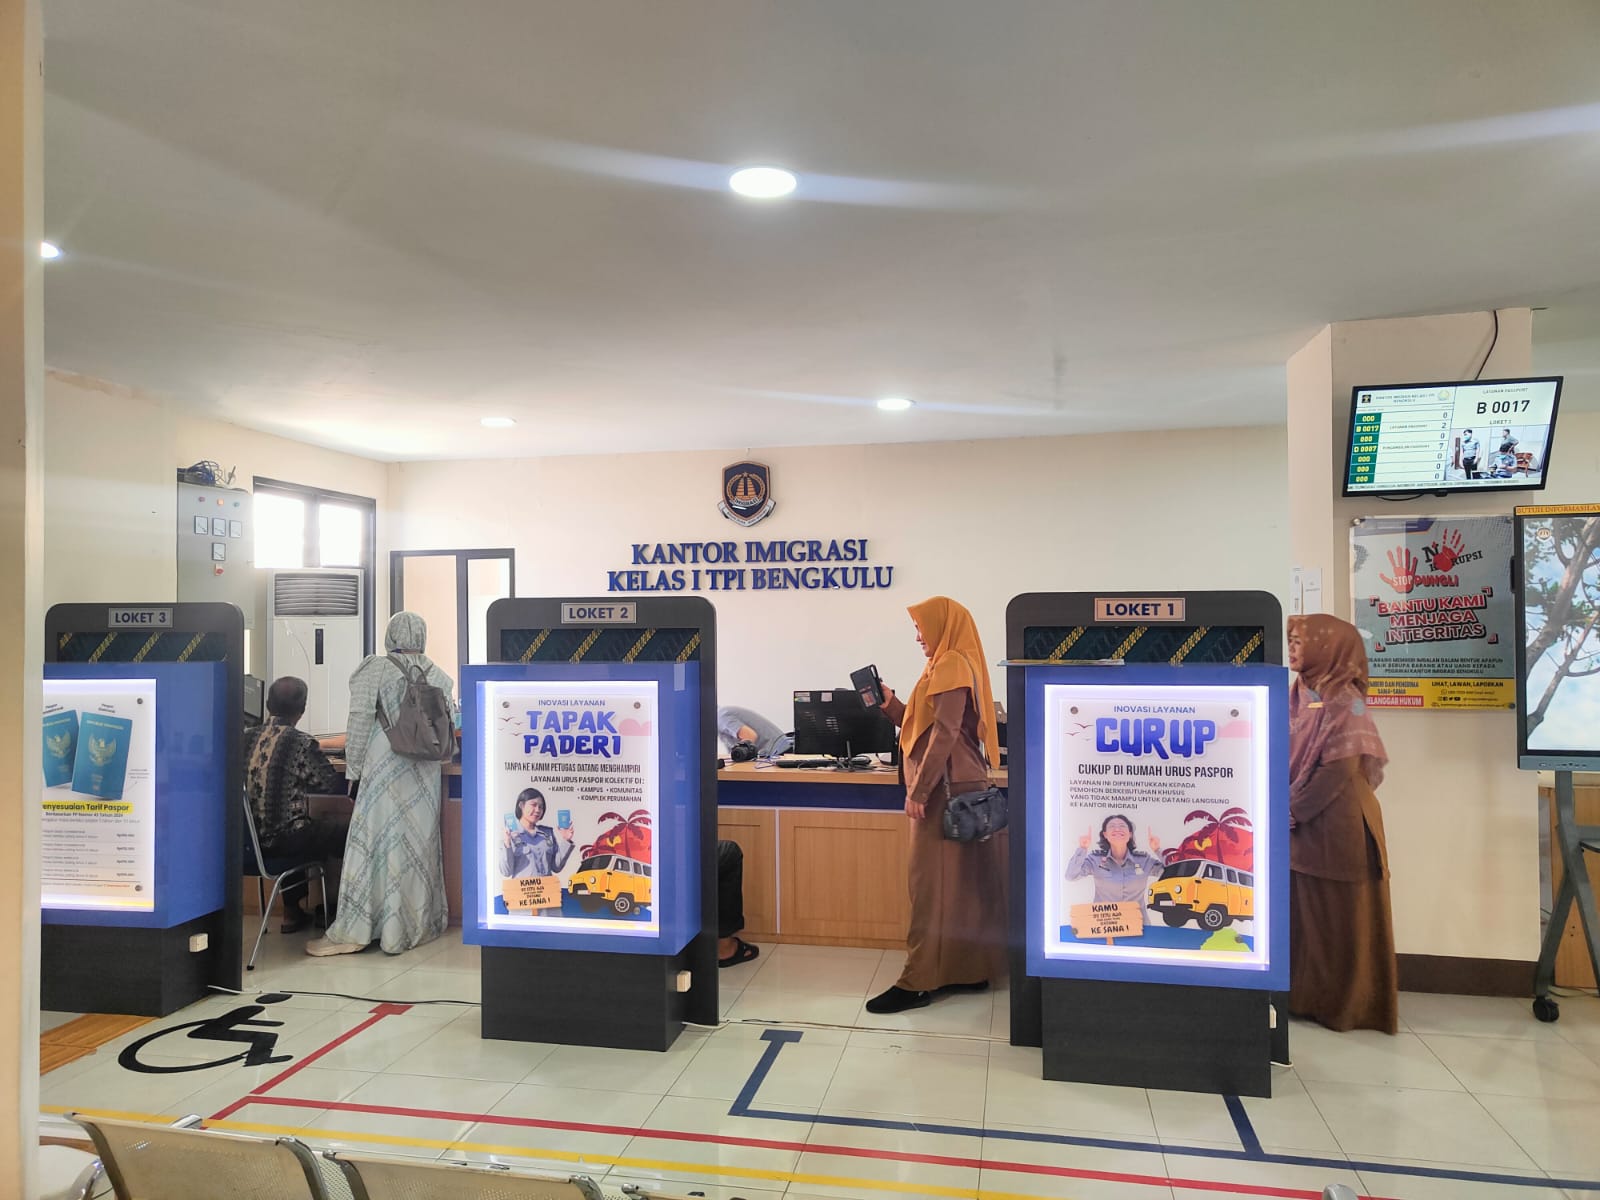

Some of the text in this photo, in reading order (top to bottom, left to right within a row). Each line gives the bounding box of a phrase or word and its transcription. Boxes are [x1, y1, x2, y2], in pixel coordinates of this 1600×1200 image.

[1477, 400, 1530, 414] B 0017
[631, 539, 868, 565] KANTOR IMIGRASI
[1429, 550, 1483, 572] KRUPSI
[607, 566, 894, 591] KELAS I TPI BENGKULU
[1393, 574, 1459, 587] STOP PUNGLI
[1106, 603, 1174, 616] LOKET 1
[1378, 594, 1485, 615] BANTU KAMI
[115, 612, 166, 624] LOKET 3
[569, 607, 628, 619] LOKET 2
[1390, 610, 1476, 627] MENJAGA
[1385, 624, 1485, 643] INTEGRITAS
[1113, 705, 1196, 714] INOVASI LAYANAN
[526, 710, 618, 733] TAPAK
[1096, 717, 1216, 760] CURUP
[523, 735, 621, 758] PADERI
[505, 762, 641, 773] TANPA KE KANIM PETUGAS DATANG MENGHAMPIRI
[1078, 764, 1233, 778] CUKUP DI RUMAH URUS PASPOR
[42, 803, 85, 811] enyesuaian
[104, 804, 129, 812] Paspor
[1092, 904, 1118, 912] KAMU
[1104, 925, 1124, 933] SANA
